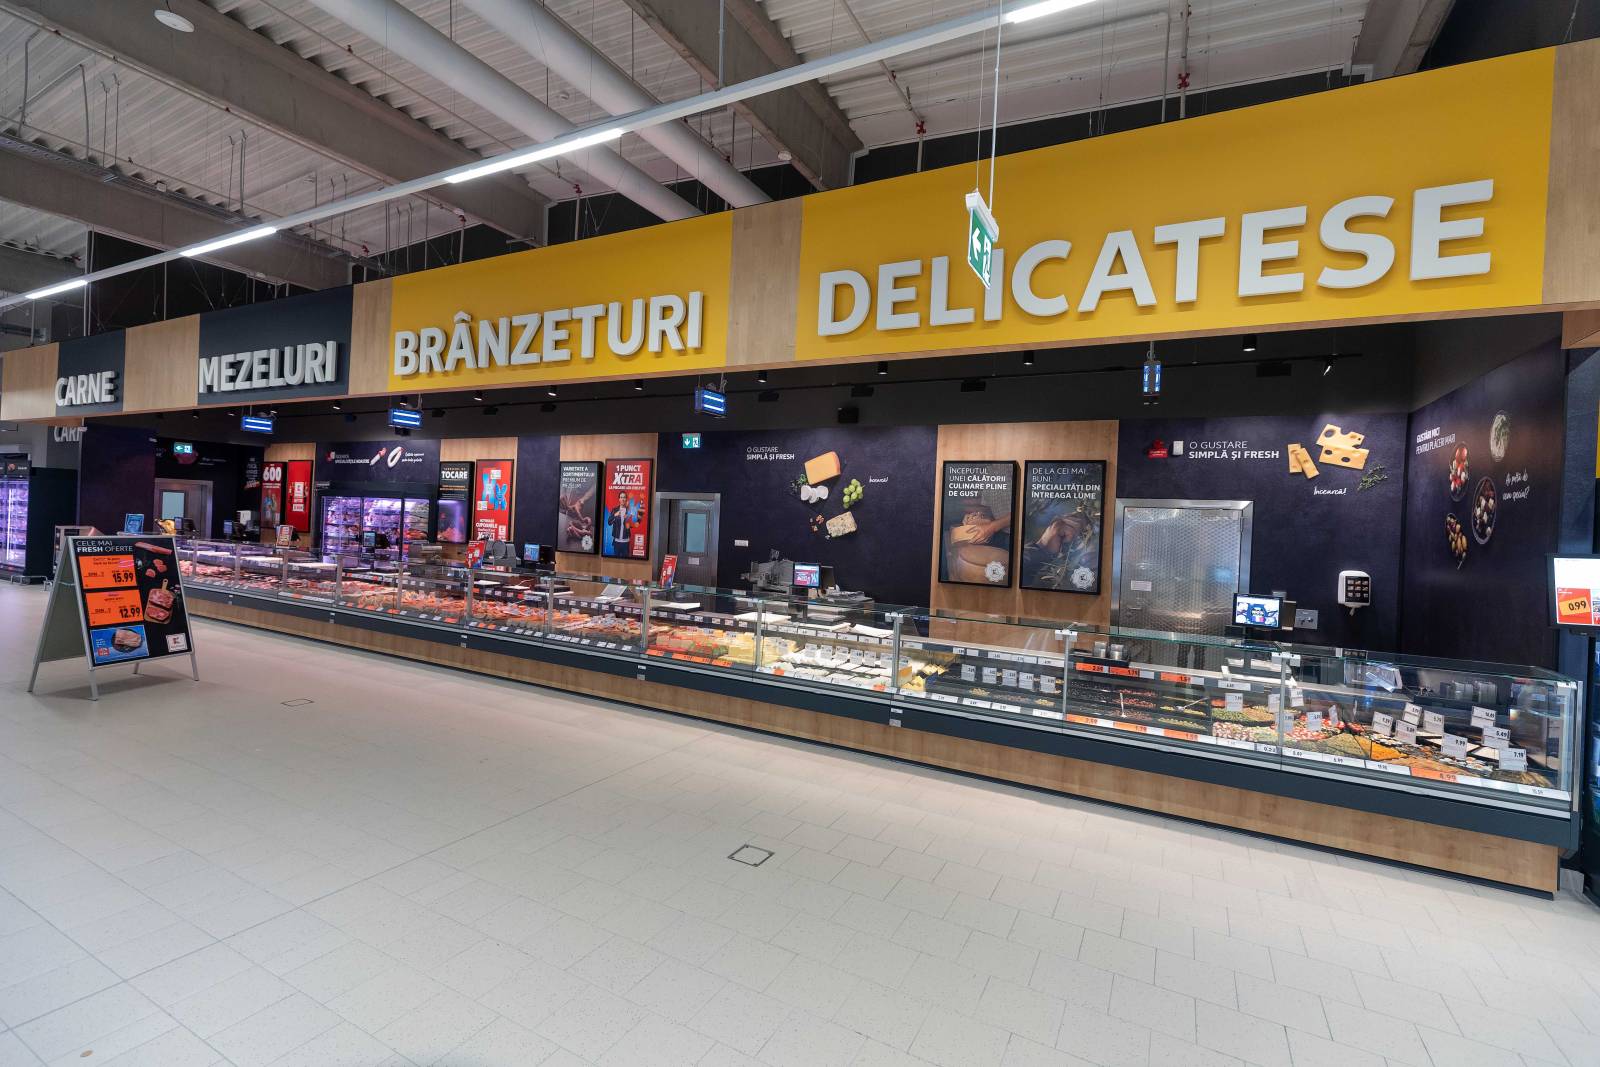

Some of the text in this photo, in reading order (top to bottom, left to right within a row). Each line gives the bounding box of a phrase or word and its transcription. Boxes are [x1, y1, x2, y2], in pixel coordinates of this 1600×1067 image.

[817, 179, 1493, 336] DELICATESE
[394, 291, 704, 376] BRÂNZETURI
[199, 340, 337, 393] MEZELURI
[55, 371, 115, 406] CARNE
[1189, 441, 1248, 449] O GUSTARE
[1188, 449, 1229, 459] SIMPLĂ
[1243, 450, 1280, 459] FRESH
[620, 464, 641, 472] PUNCT
[949, 467, 988, 475] ÎNCEPUTUL
[263, 467, 282, 481] 600
[441, 471, 468, 479] TOCARE
[967, 474, 1006, 482] CĂLĂTORII
[1031, 482, 1084, 492] SPECIALITĂȚI
[1031, 490, 1097, 500] ÎNTREAGA LUME
[112, 572, 133, 582] 15.99
[1568, 600, 1587, 611] 0.99
[119, 607, 140, 618] 12.99
